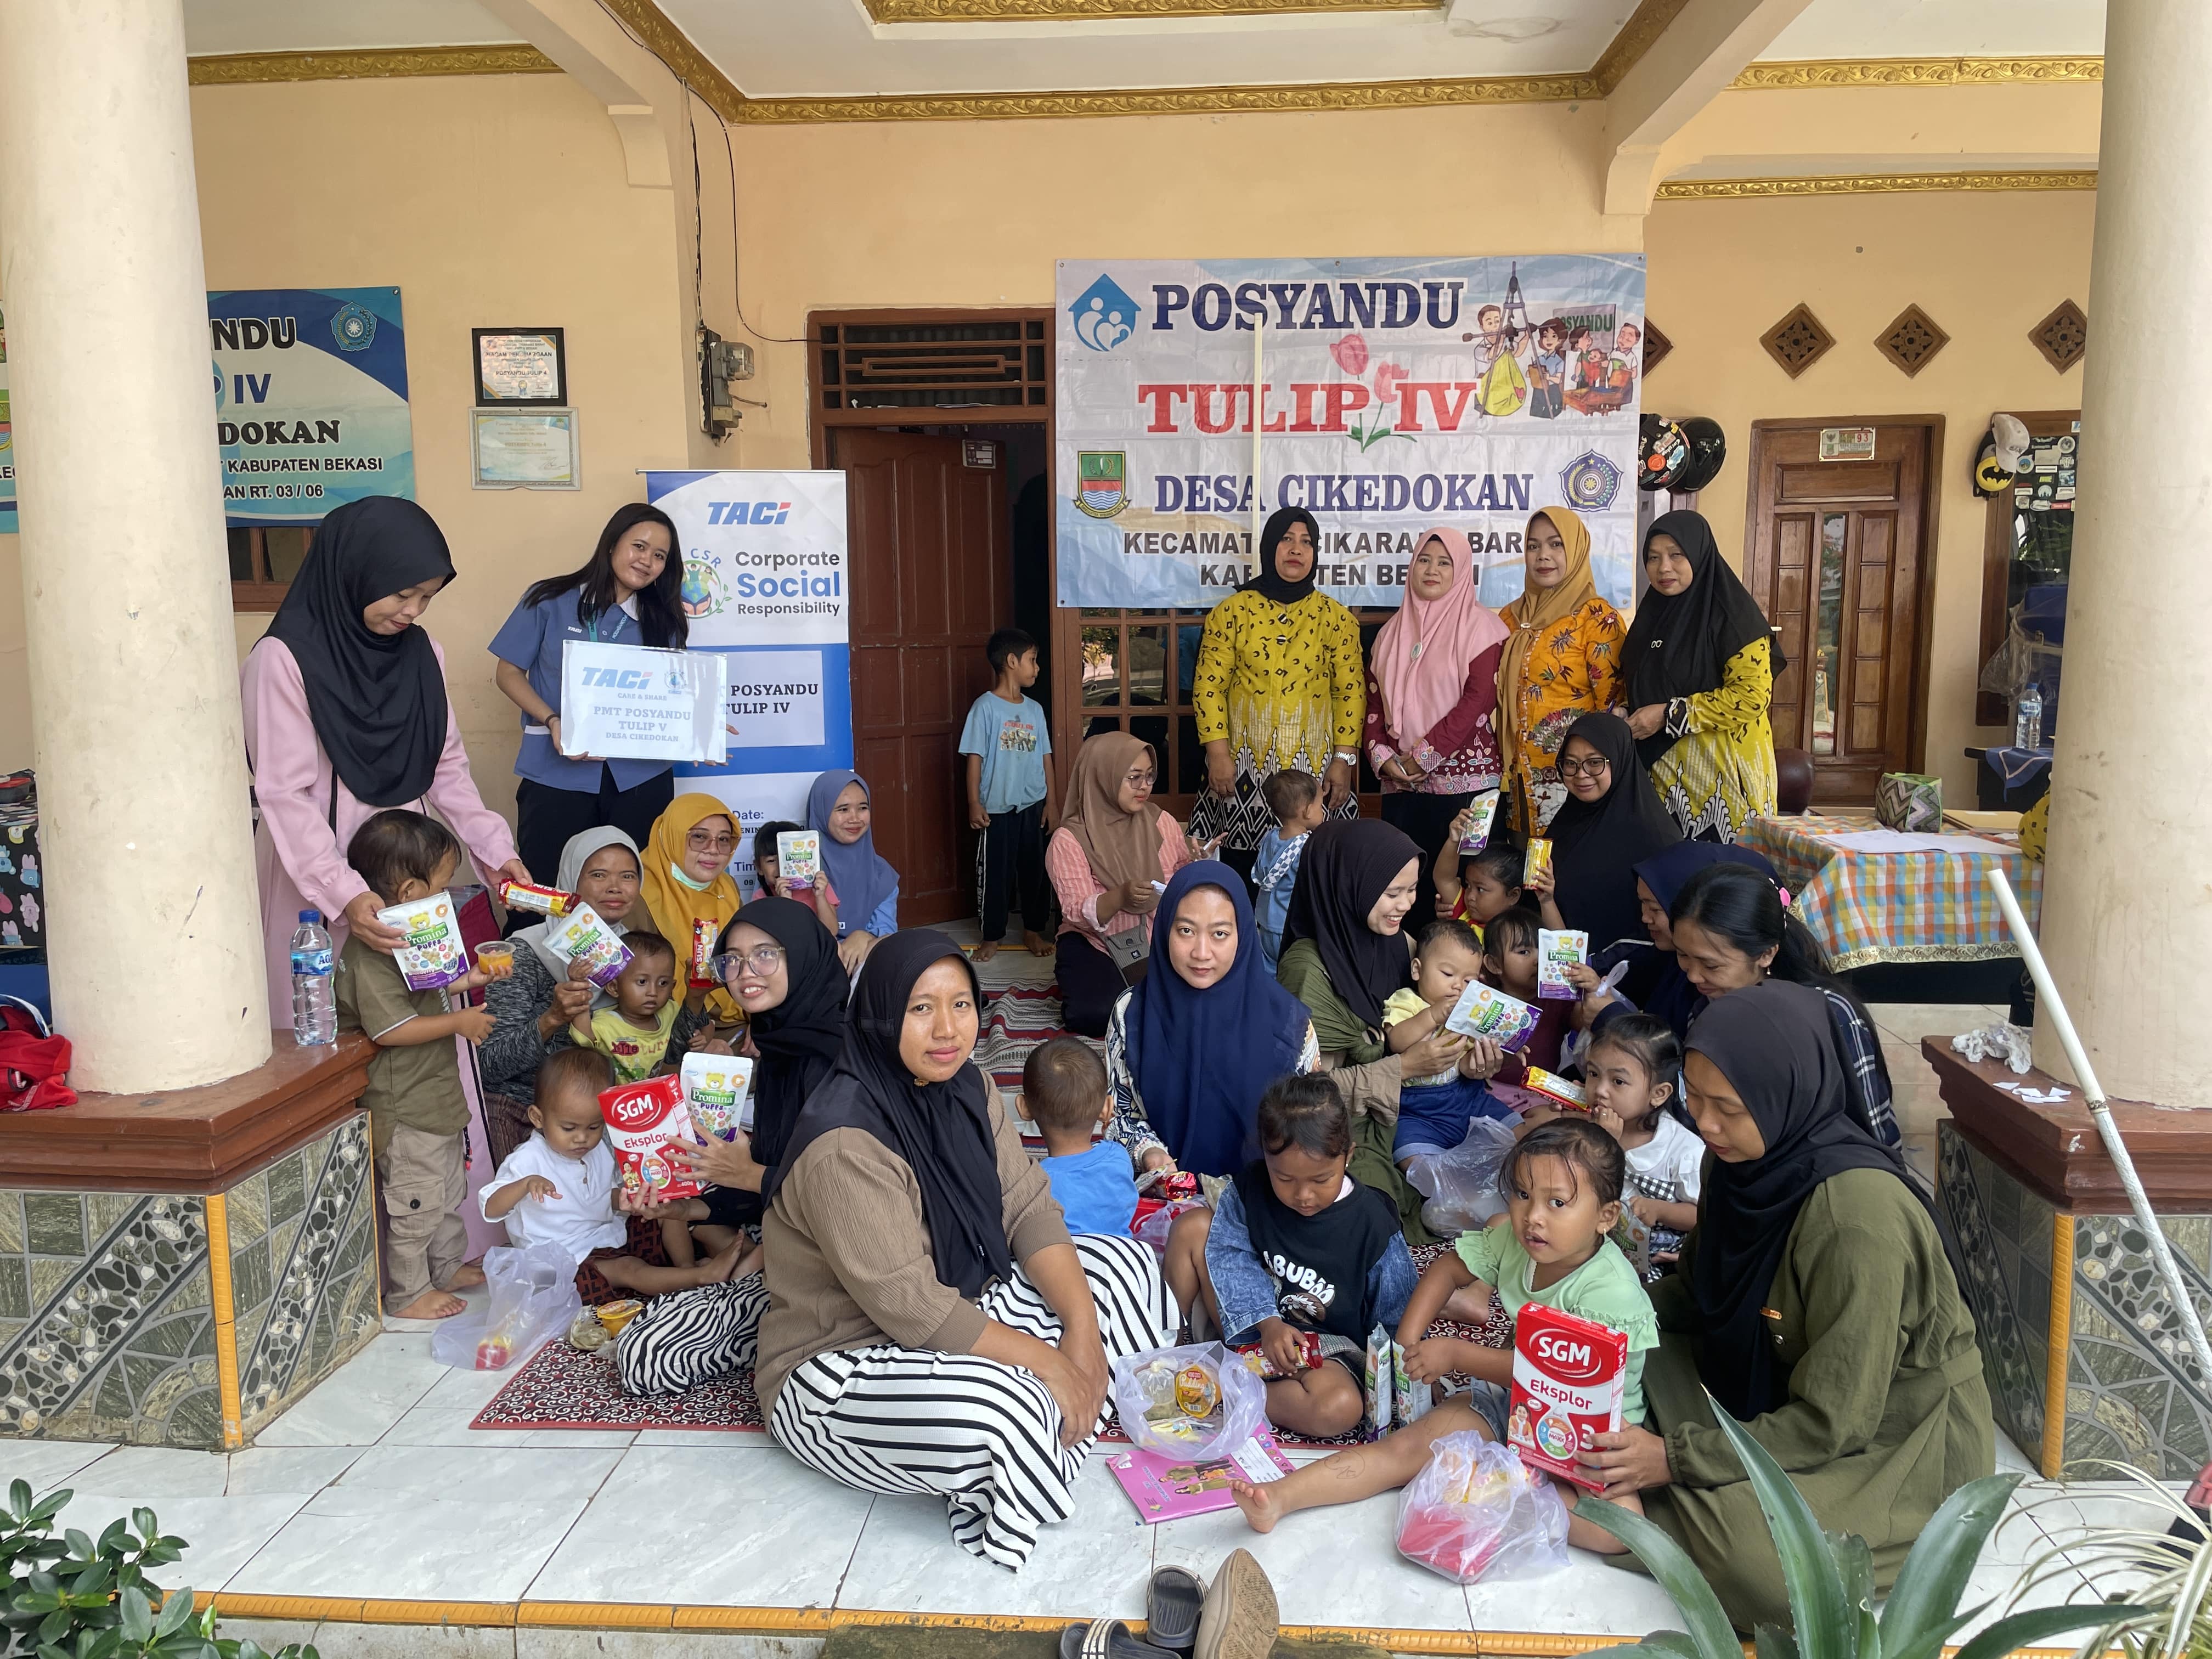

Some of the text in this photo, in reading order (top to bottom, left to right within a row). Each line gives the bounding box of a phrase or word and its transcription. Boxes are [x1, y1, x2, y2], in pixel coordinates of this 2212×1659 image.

[1152, 281, 1464, 331] POSYANDU
[1561, 314, 1613, 332] OSYANDU
[211, 317, 296, 351] NDU
[234, 373, 272, 404] IV
[1138, 382, 1477, 433] TULIP IV
[218, 420, 340, 445] DOKAN
[228, 458, 382, 472] KABUPATEN BEKASI
[223, 486, 245, 498] AN
[250, 486, 272, 498] RT.
[306, 484, 323, 496] 06
[1154, 473, 1534, 512] DESA CIKEDOKAN
[1125, 532, 1523, 554] KECAMAT IKARA BAR
[735, 551, 840, 571] Corporate
[737, 569, 840, 598] Social
[738, 602, 840, 617] Responsibility
[731, 684, 819, 697] POSYANDU
[594, 706, 691, 720] PMT POSYANDU
[774, 702, 791, 714] IV
[618, 720, 668, 732] TULIP V
[629, 733, 679, 742] CIKEDOKAN
[732, 809, 764, 820] Date:
[734, 861, 756, 872] Tim
[568, 931, 600, 956] Promina
[319, 953, 333, 964] AQ
[1550, 951, 1578, 961] Promina
[1479, 1003, 1503, 1032] Promina
[692, 1090, 732, 1104] Promina
[617, 1094, 653, 1121] SGM
[624, 1133, 667, 1149] Eksplor
[1538, 1336, 1590, 1367] SGM
[1530, 1379, 1593, 1410] Eksplor
